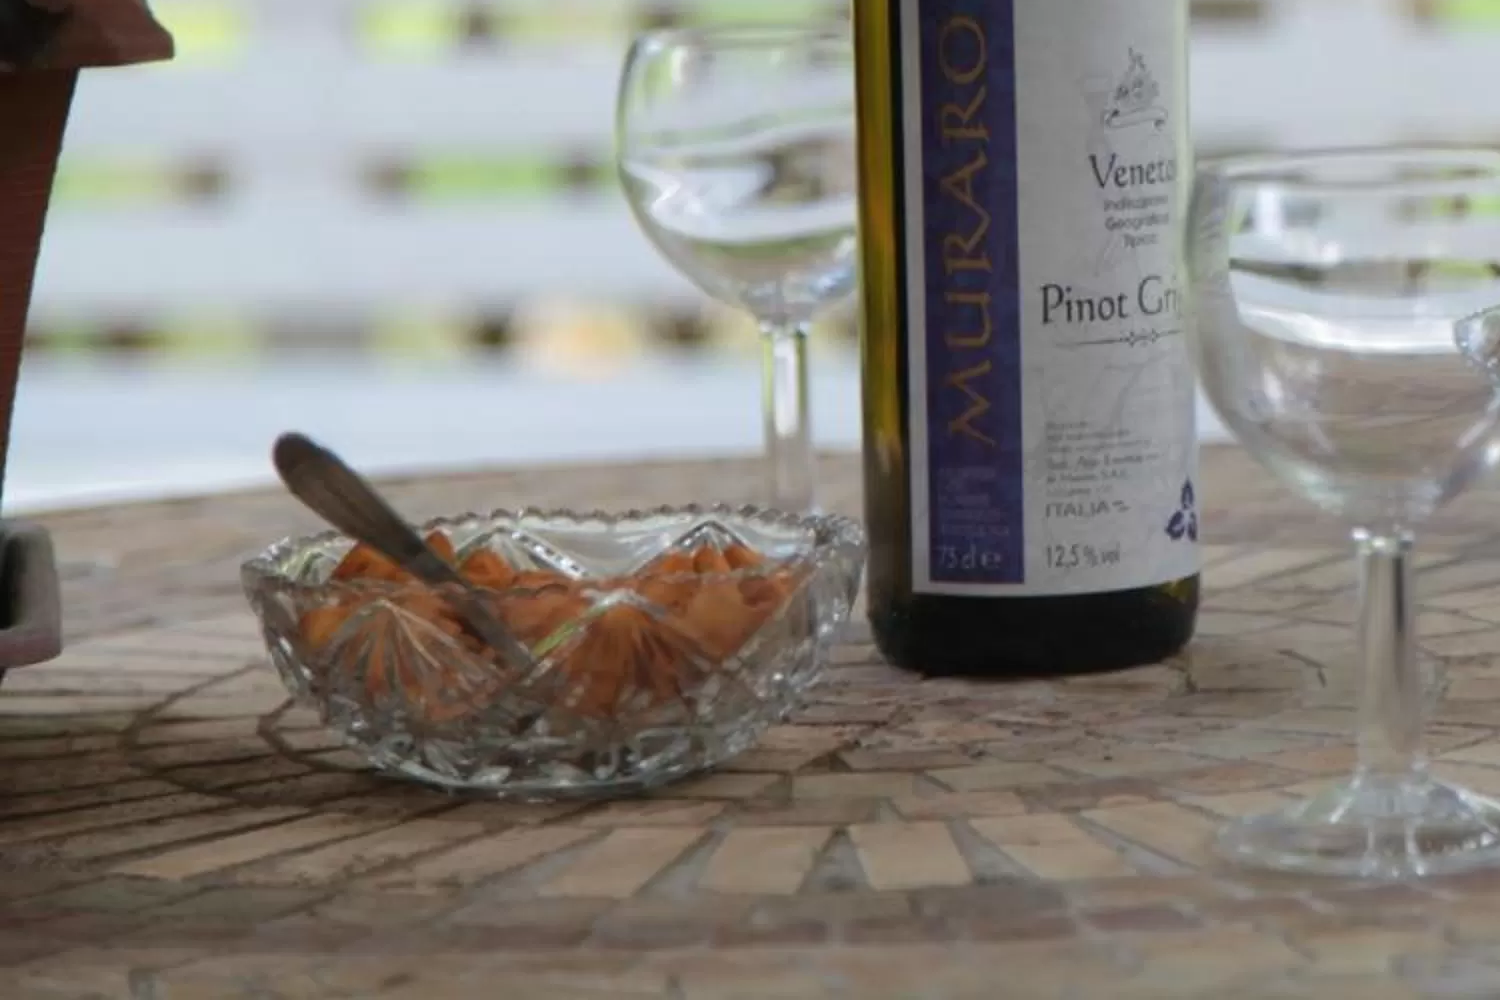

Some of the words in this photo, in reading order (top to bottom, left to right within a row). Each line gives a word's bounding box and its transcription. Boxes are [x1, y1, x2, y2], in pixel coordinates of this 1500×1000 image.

[938, 15, 997, 447] MURARO
[1040, 282, 1129, 325] Pinot
[1045, 500, 1111, 519] ITALIA
